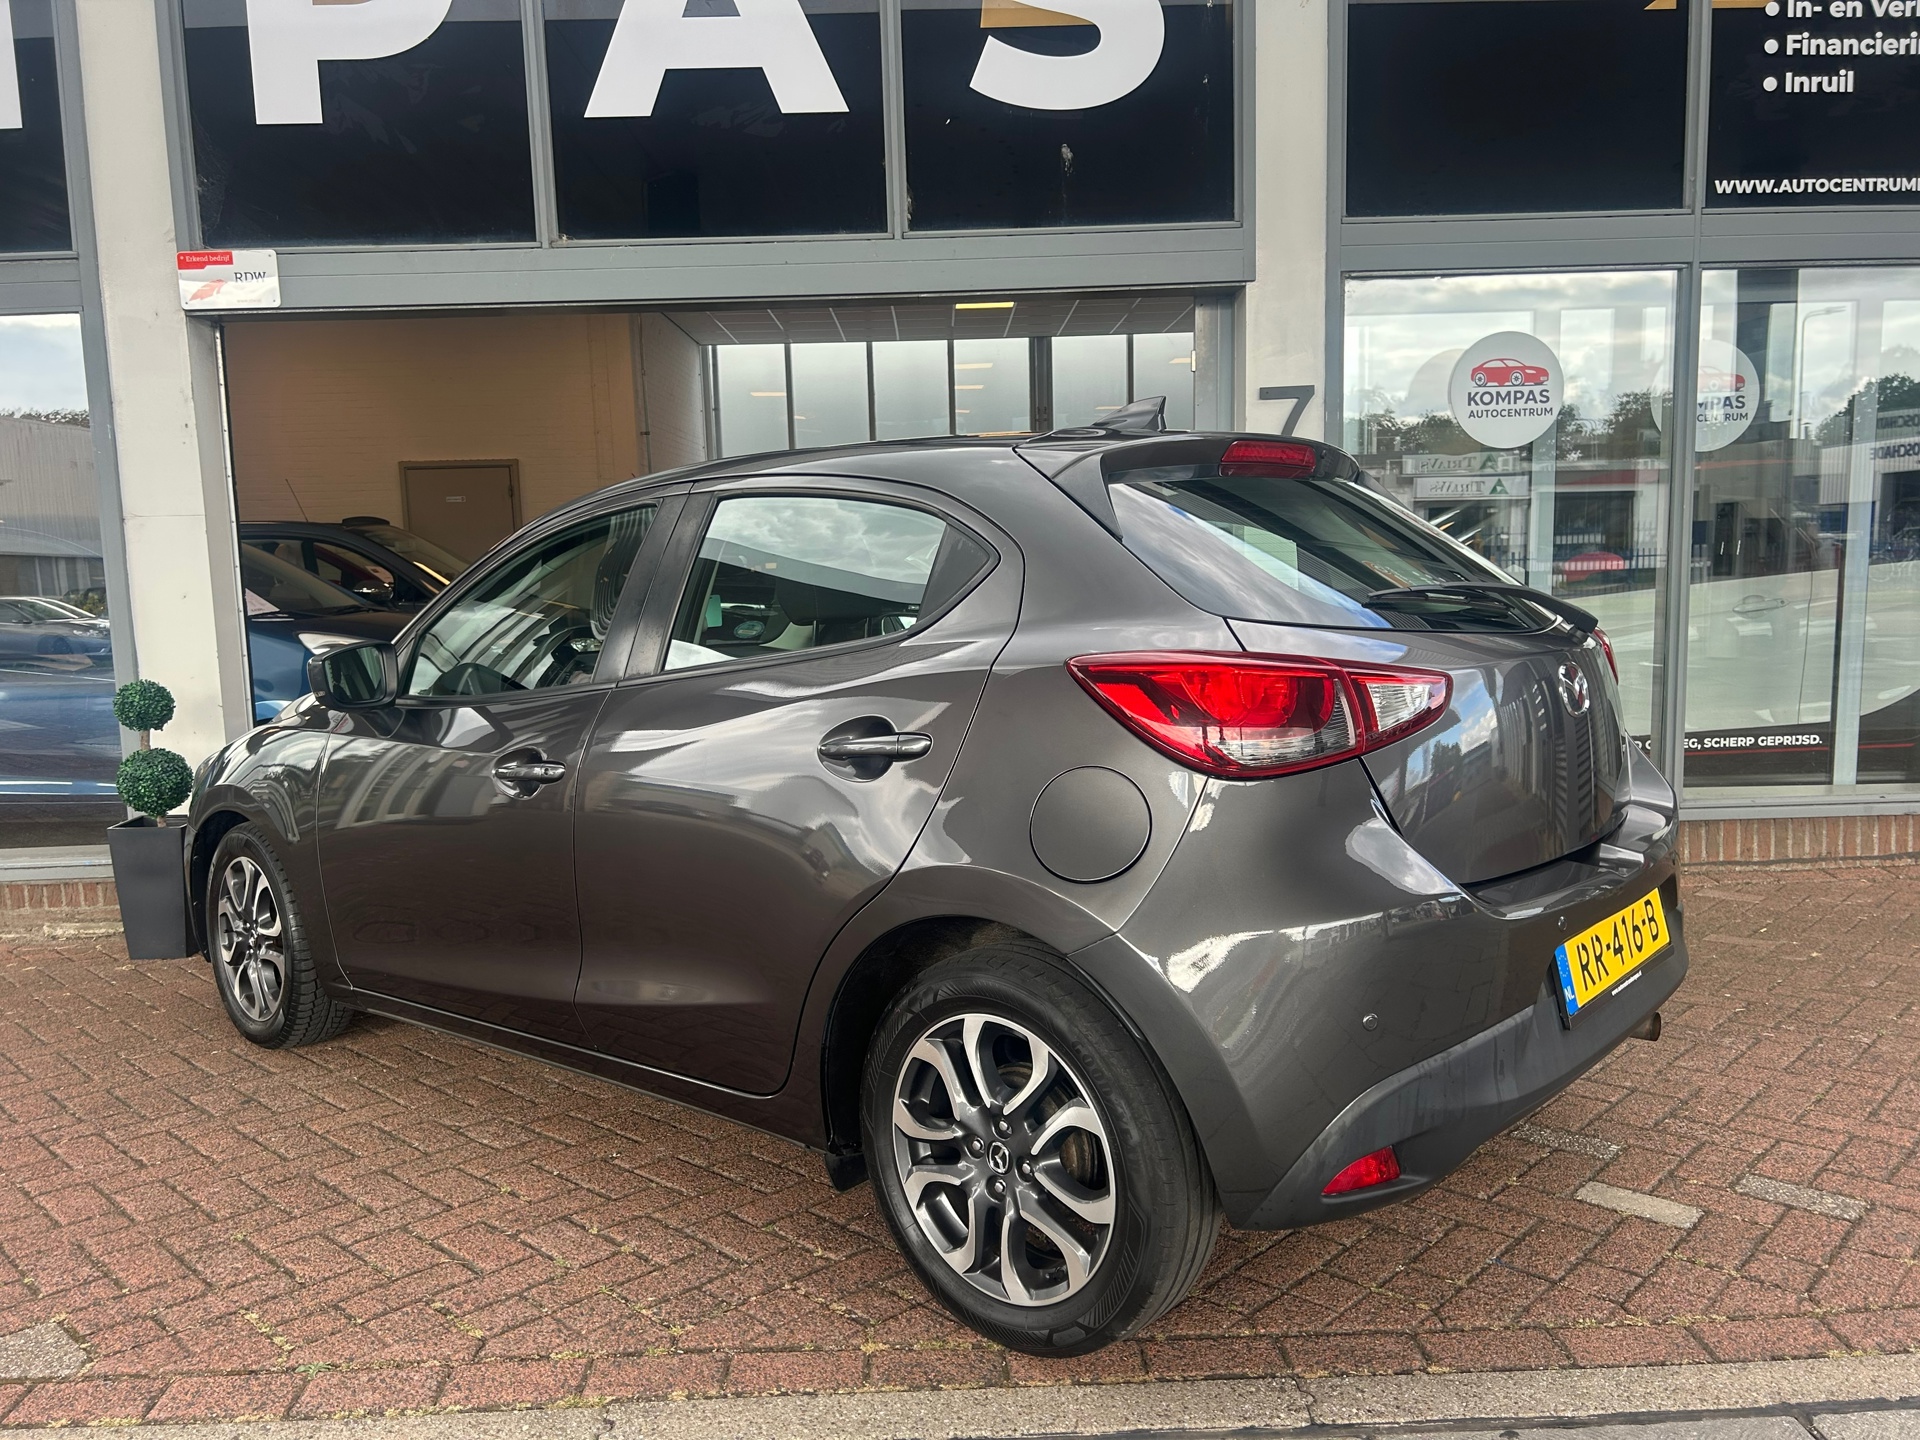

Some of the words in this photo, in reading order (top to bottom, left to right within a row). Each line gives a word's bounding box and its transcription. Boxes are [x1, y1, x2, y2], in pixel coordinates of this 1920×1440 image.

[1787, 0, 1822, 18] In-
[1829, 0, 1863, 18] en
[1870, 0, 1920, 18] Ver
[1786, 31, 1920, 56] Financieri
[1785, 69, 1854, 93] Inruil
[1714, 177, 1920, 194] WWW.AUTOCENTRUM
[185, 255, 208, 263] Erkend
[209, 254, 230, 263] bedrijf
[233, 271, 266, 283] RDW
[1467, 389, 1550, 407] KOMPAS
[1259, 385, 1315, 436] 7
[1468, 407, 1554, 419] AUTOCENTRUM
[1703, 736, 1755, 749] SCHERP
[1757, 734, 1823, 747] GEPRIJSD.
[1576, 899, 1659, 992] RR-416-B
[1563, 985, 1575, 1002] NL
